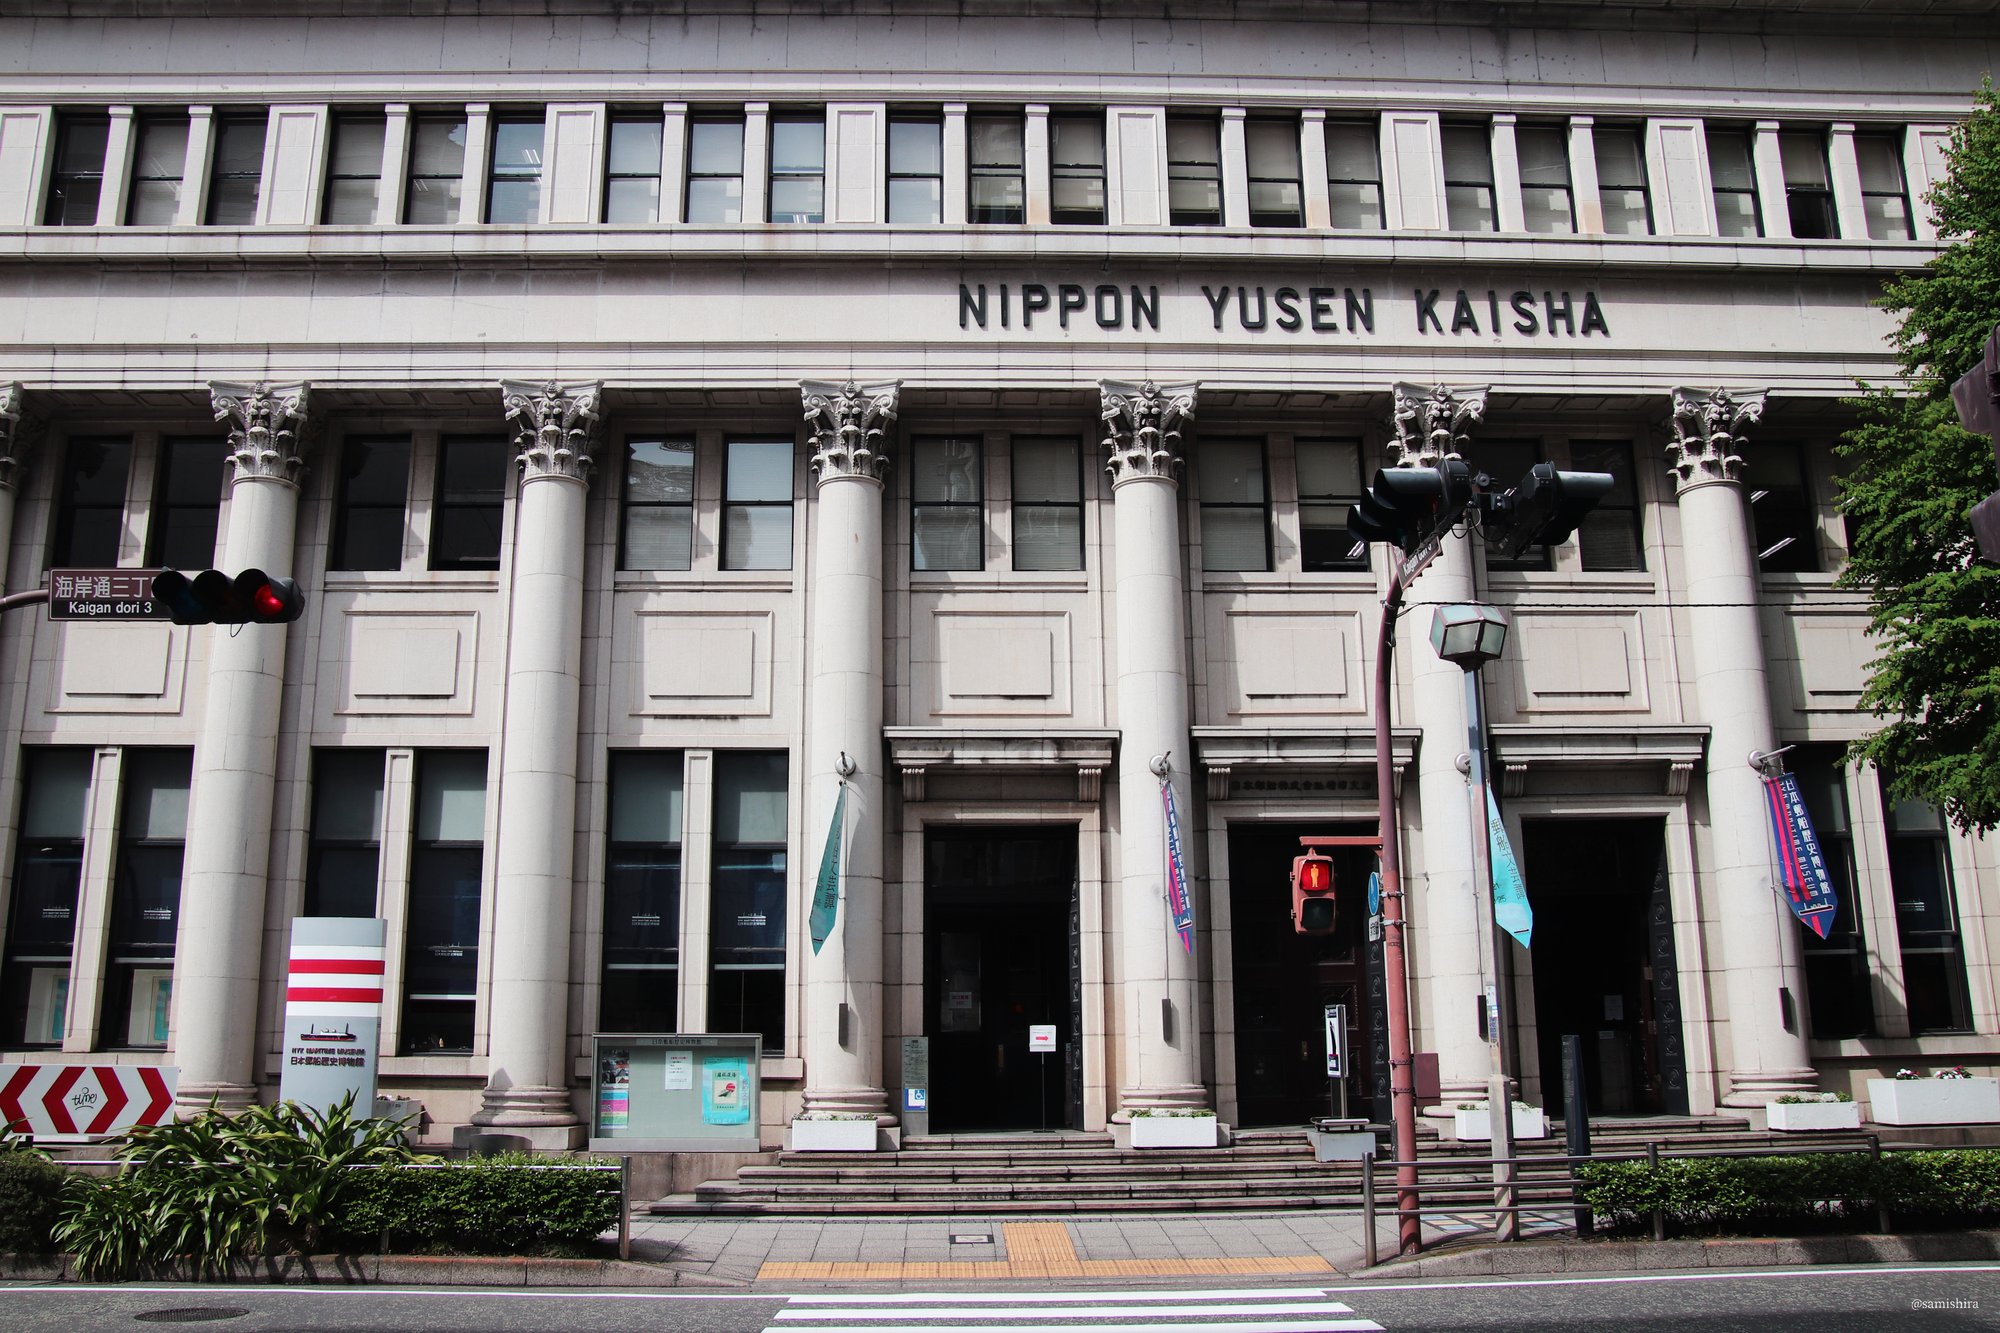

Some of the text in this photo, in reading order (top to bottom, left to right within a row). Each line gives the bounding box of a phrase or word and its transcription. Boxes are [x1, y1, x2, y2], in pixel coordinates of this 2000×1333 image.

[959, 283, 1609, 336] NIPPON YUSEN KAISHA
[55, 576, 156, 599] 海岸通三丁
[69, 601, 153, 615] Kaigan dori 3
